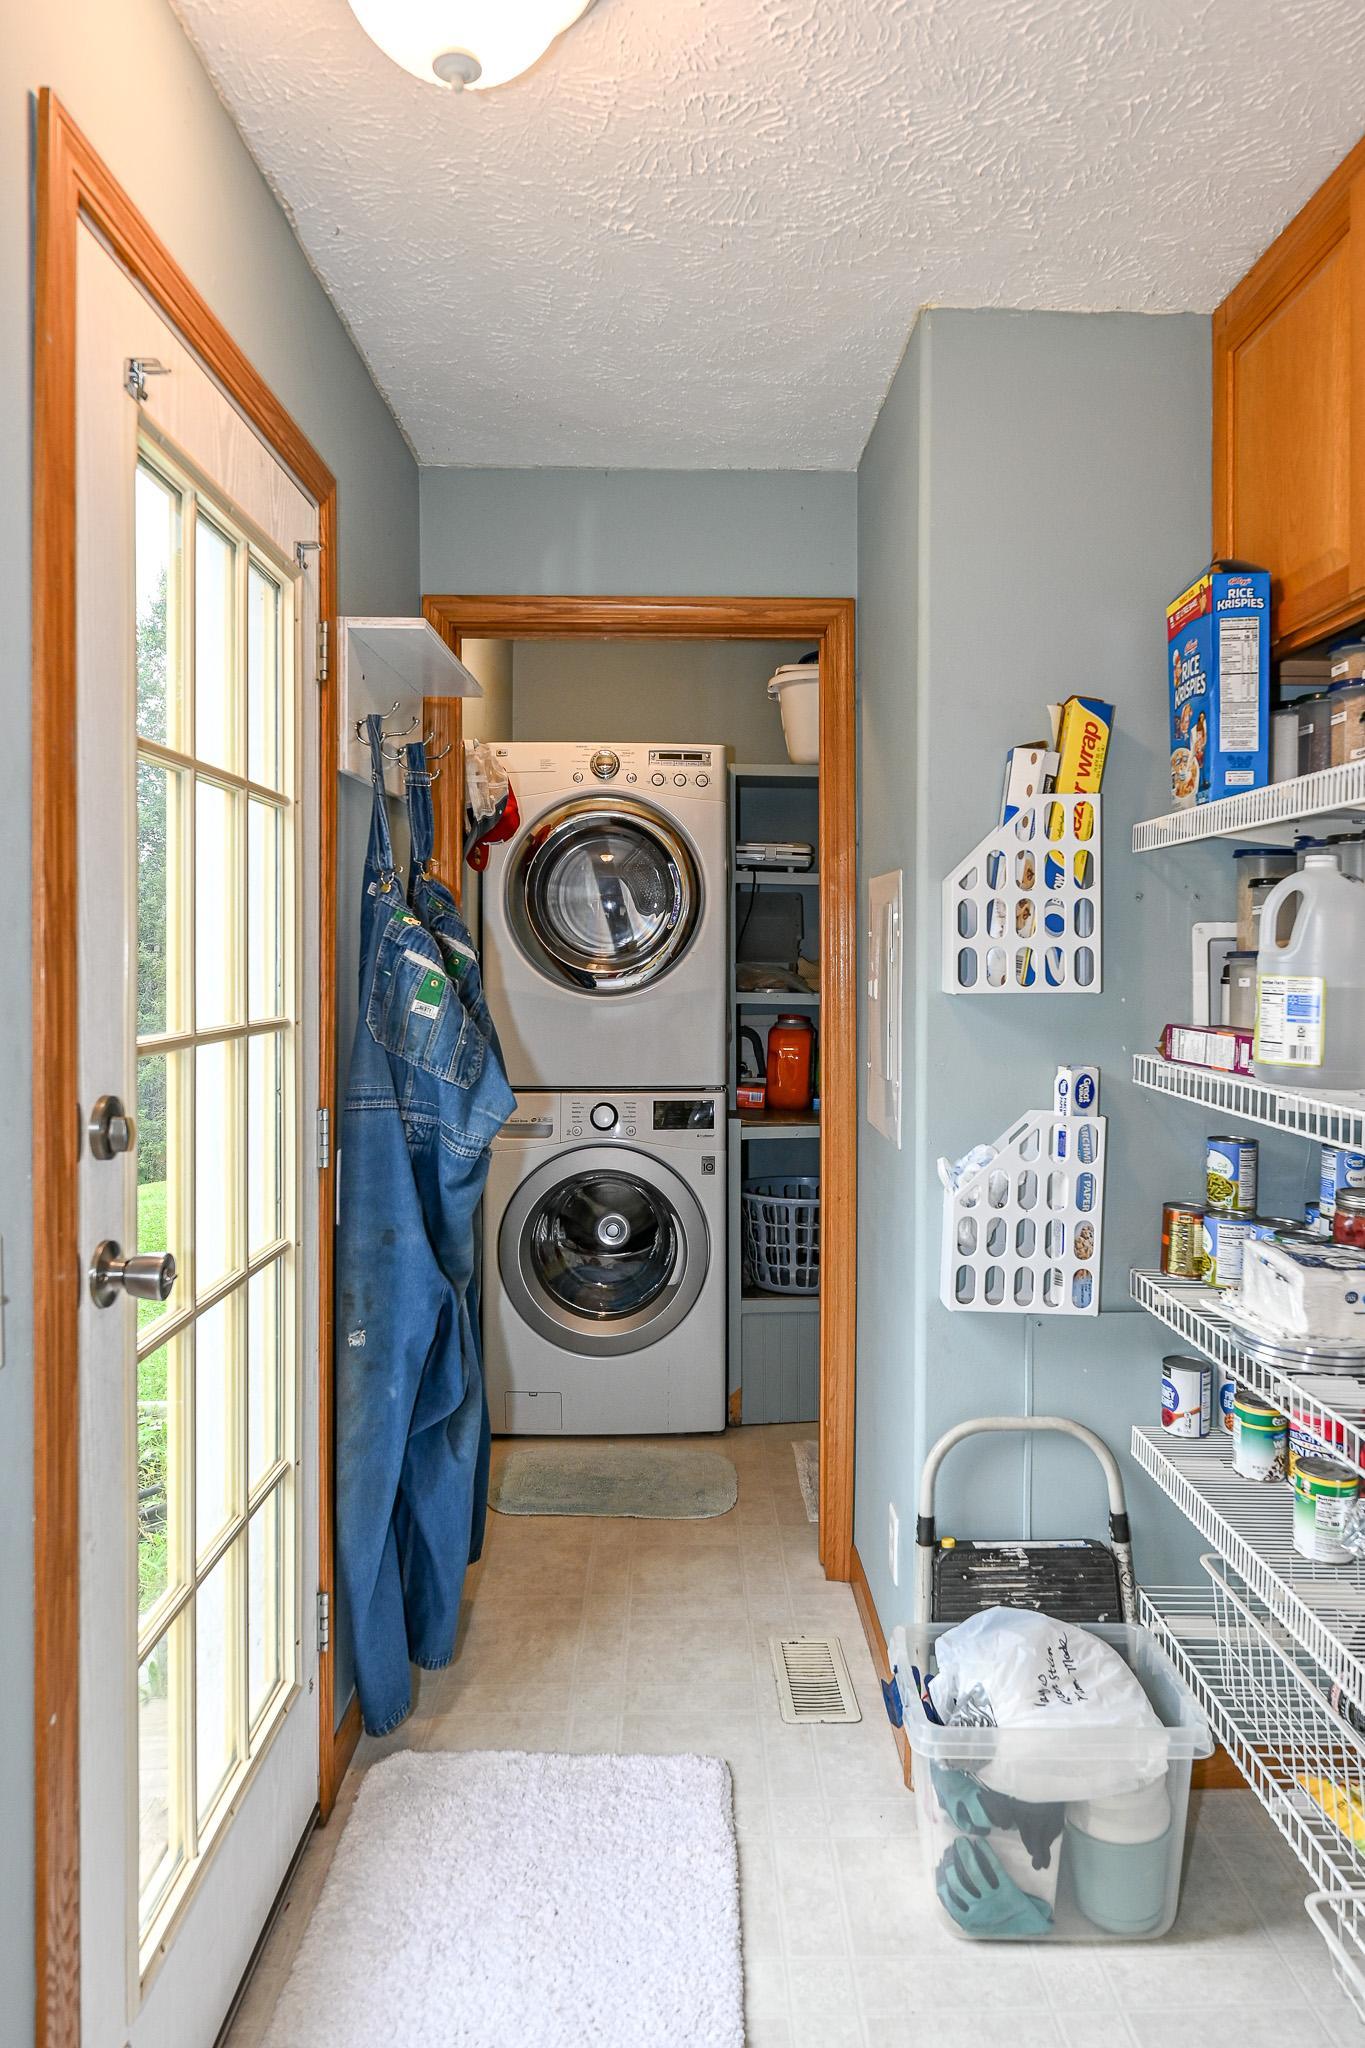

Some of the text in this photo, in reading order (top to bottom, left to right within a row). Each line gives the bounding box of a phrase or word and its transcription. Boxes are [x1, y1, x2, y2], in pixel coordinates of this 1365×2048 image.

[1217, 598, 1264, 611] KRISPIES
[1228, 588, 1254, 599] RICE
[1182, 654, 1200, 683] RICE
[1175, 673, 1206, 710] KRISPIES
[1077, 721, 1102, 777] wrap
[1083, 1078, 1092, 1103] Great
